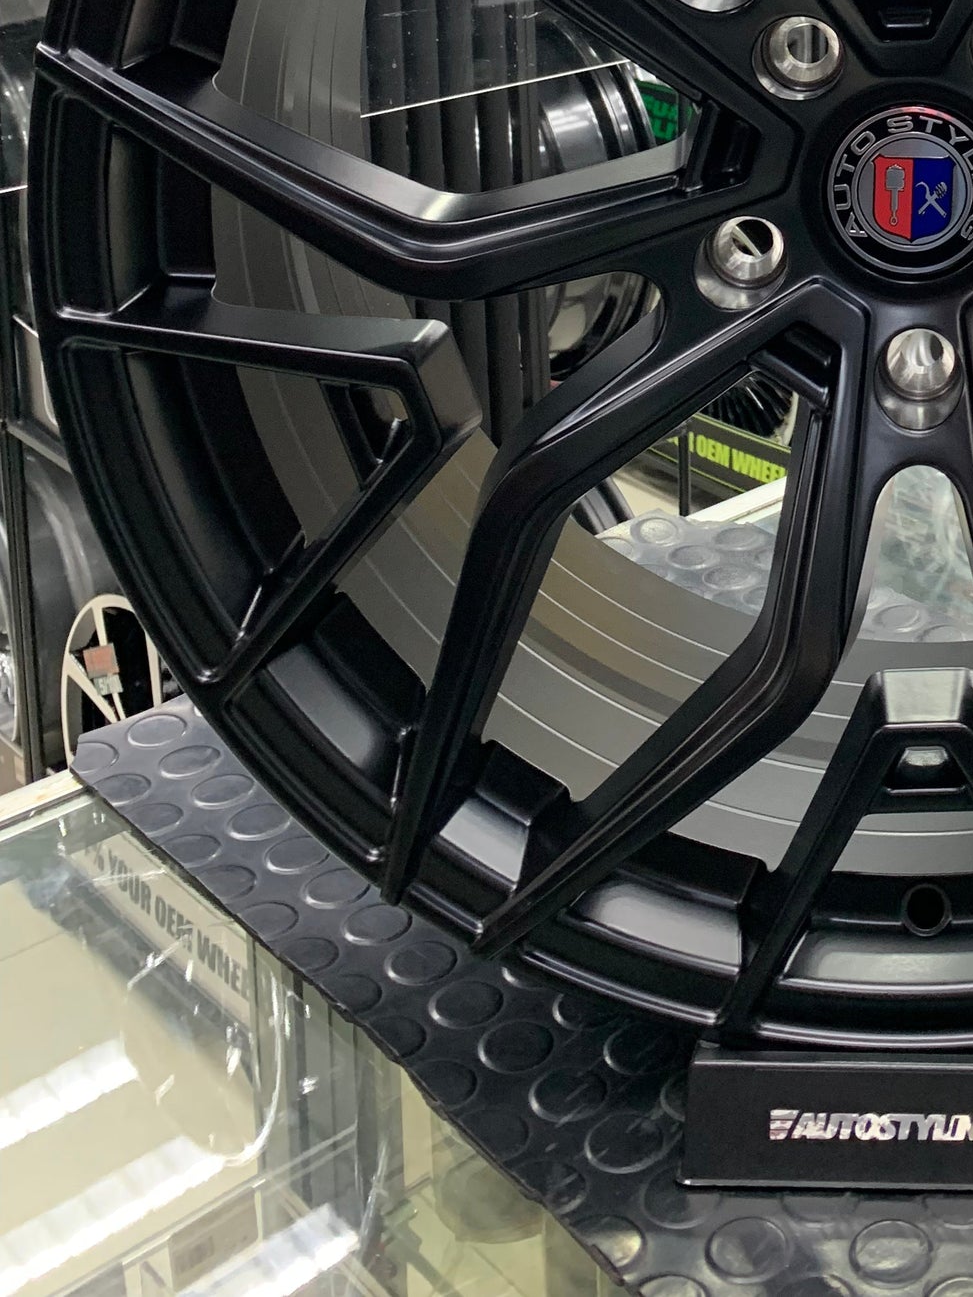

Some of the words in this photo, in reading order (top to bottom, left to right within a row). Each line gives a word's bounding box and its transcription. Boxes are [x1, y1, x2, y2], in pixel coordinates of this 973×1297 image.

[833, 130, 876, 239] AUTO
[695, 433, 730, 468] OEM
[108, 849, 151, 915] YOUR
[154, 895, 194, 953] OEM
